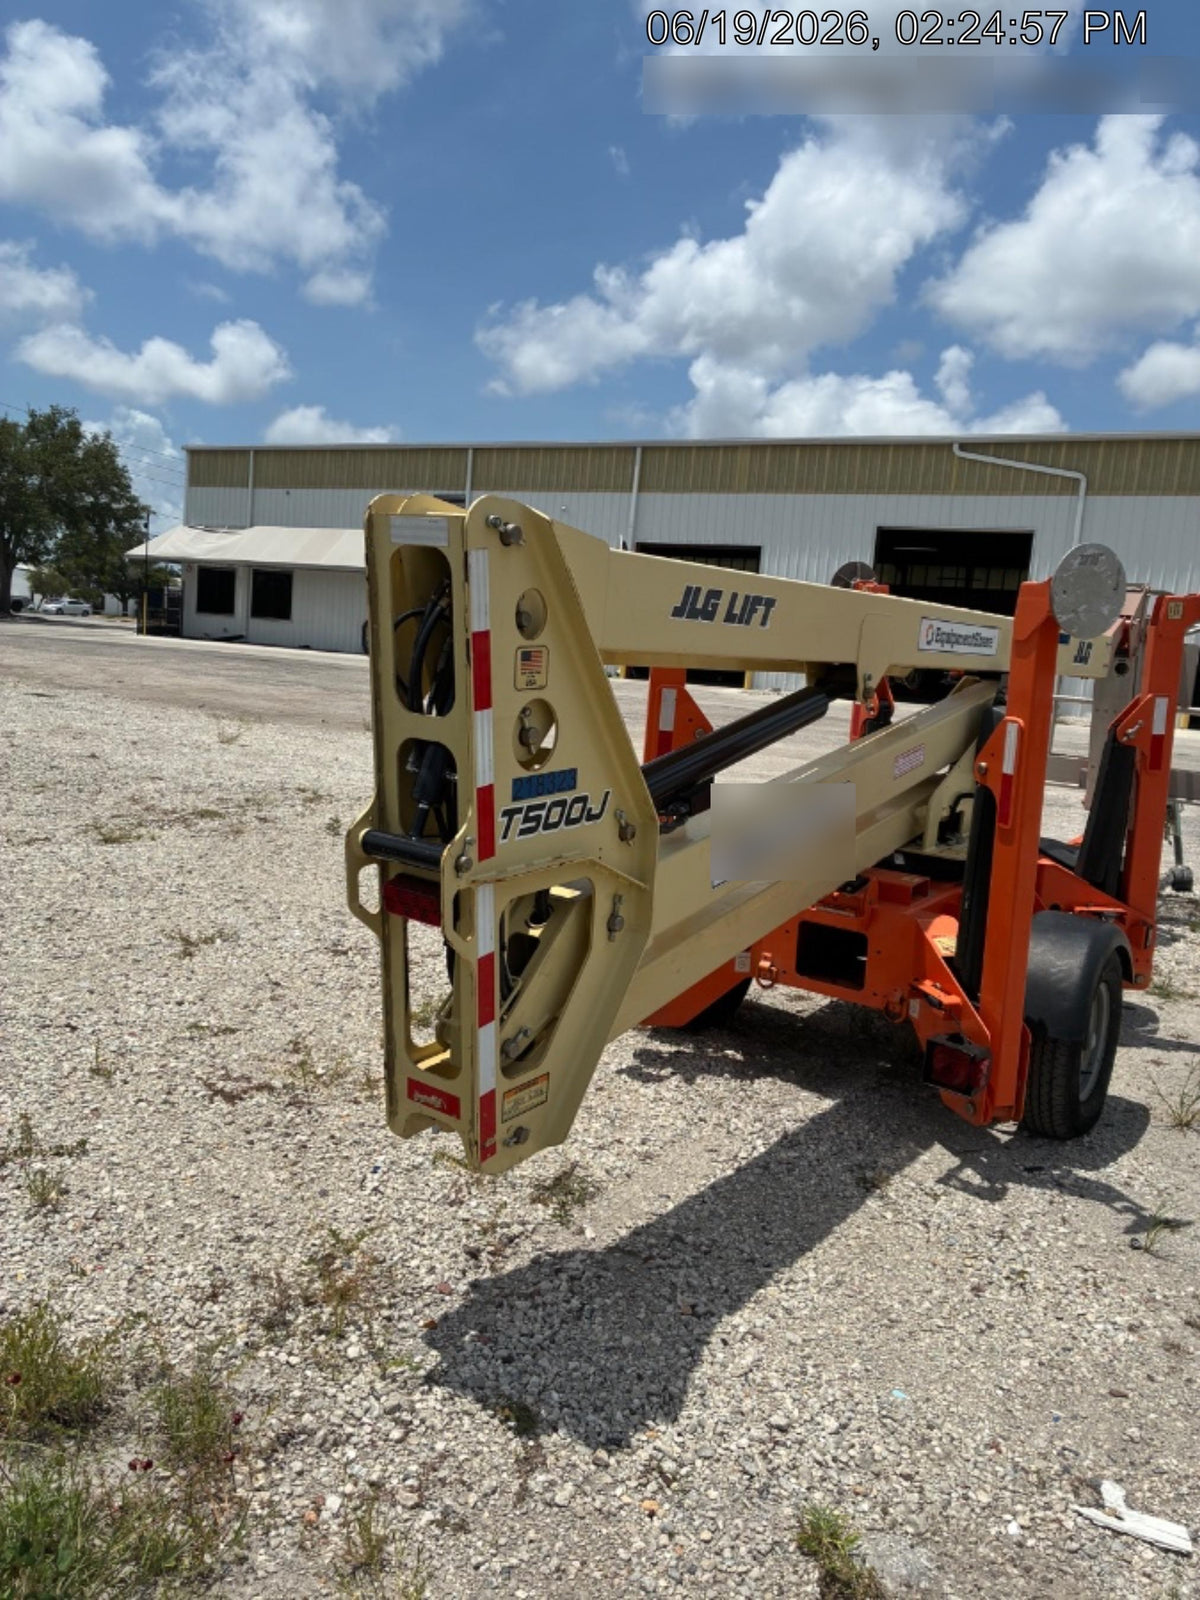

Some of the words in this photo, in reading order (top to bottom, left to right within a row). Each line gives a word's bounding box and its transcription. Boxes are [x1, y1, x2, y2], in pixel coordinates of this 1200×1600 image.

[670, 585, 724, 623] JLG
[723, 591, 777, 628] LIFT
[500, 789, 611, 842] T500J
